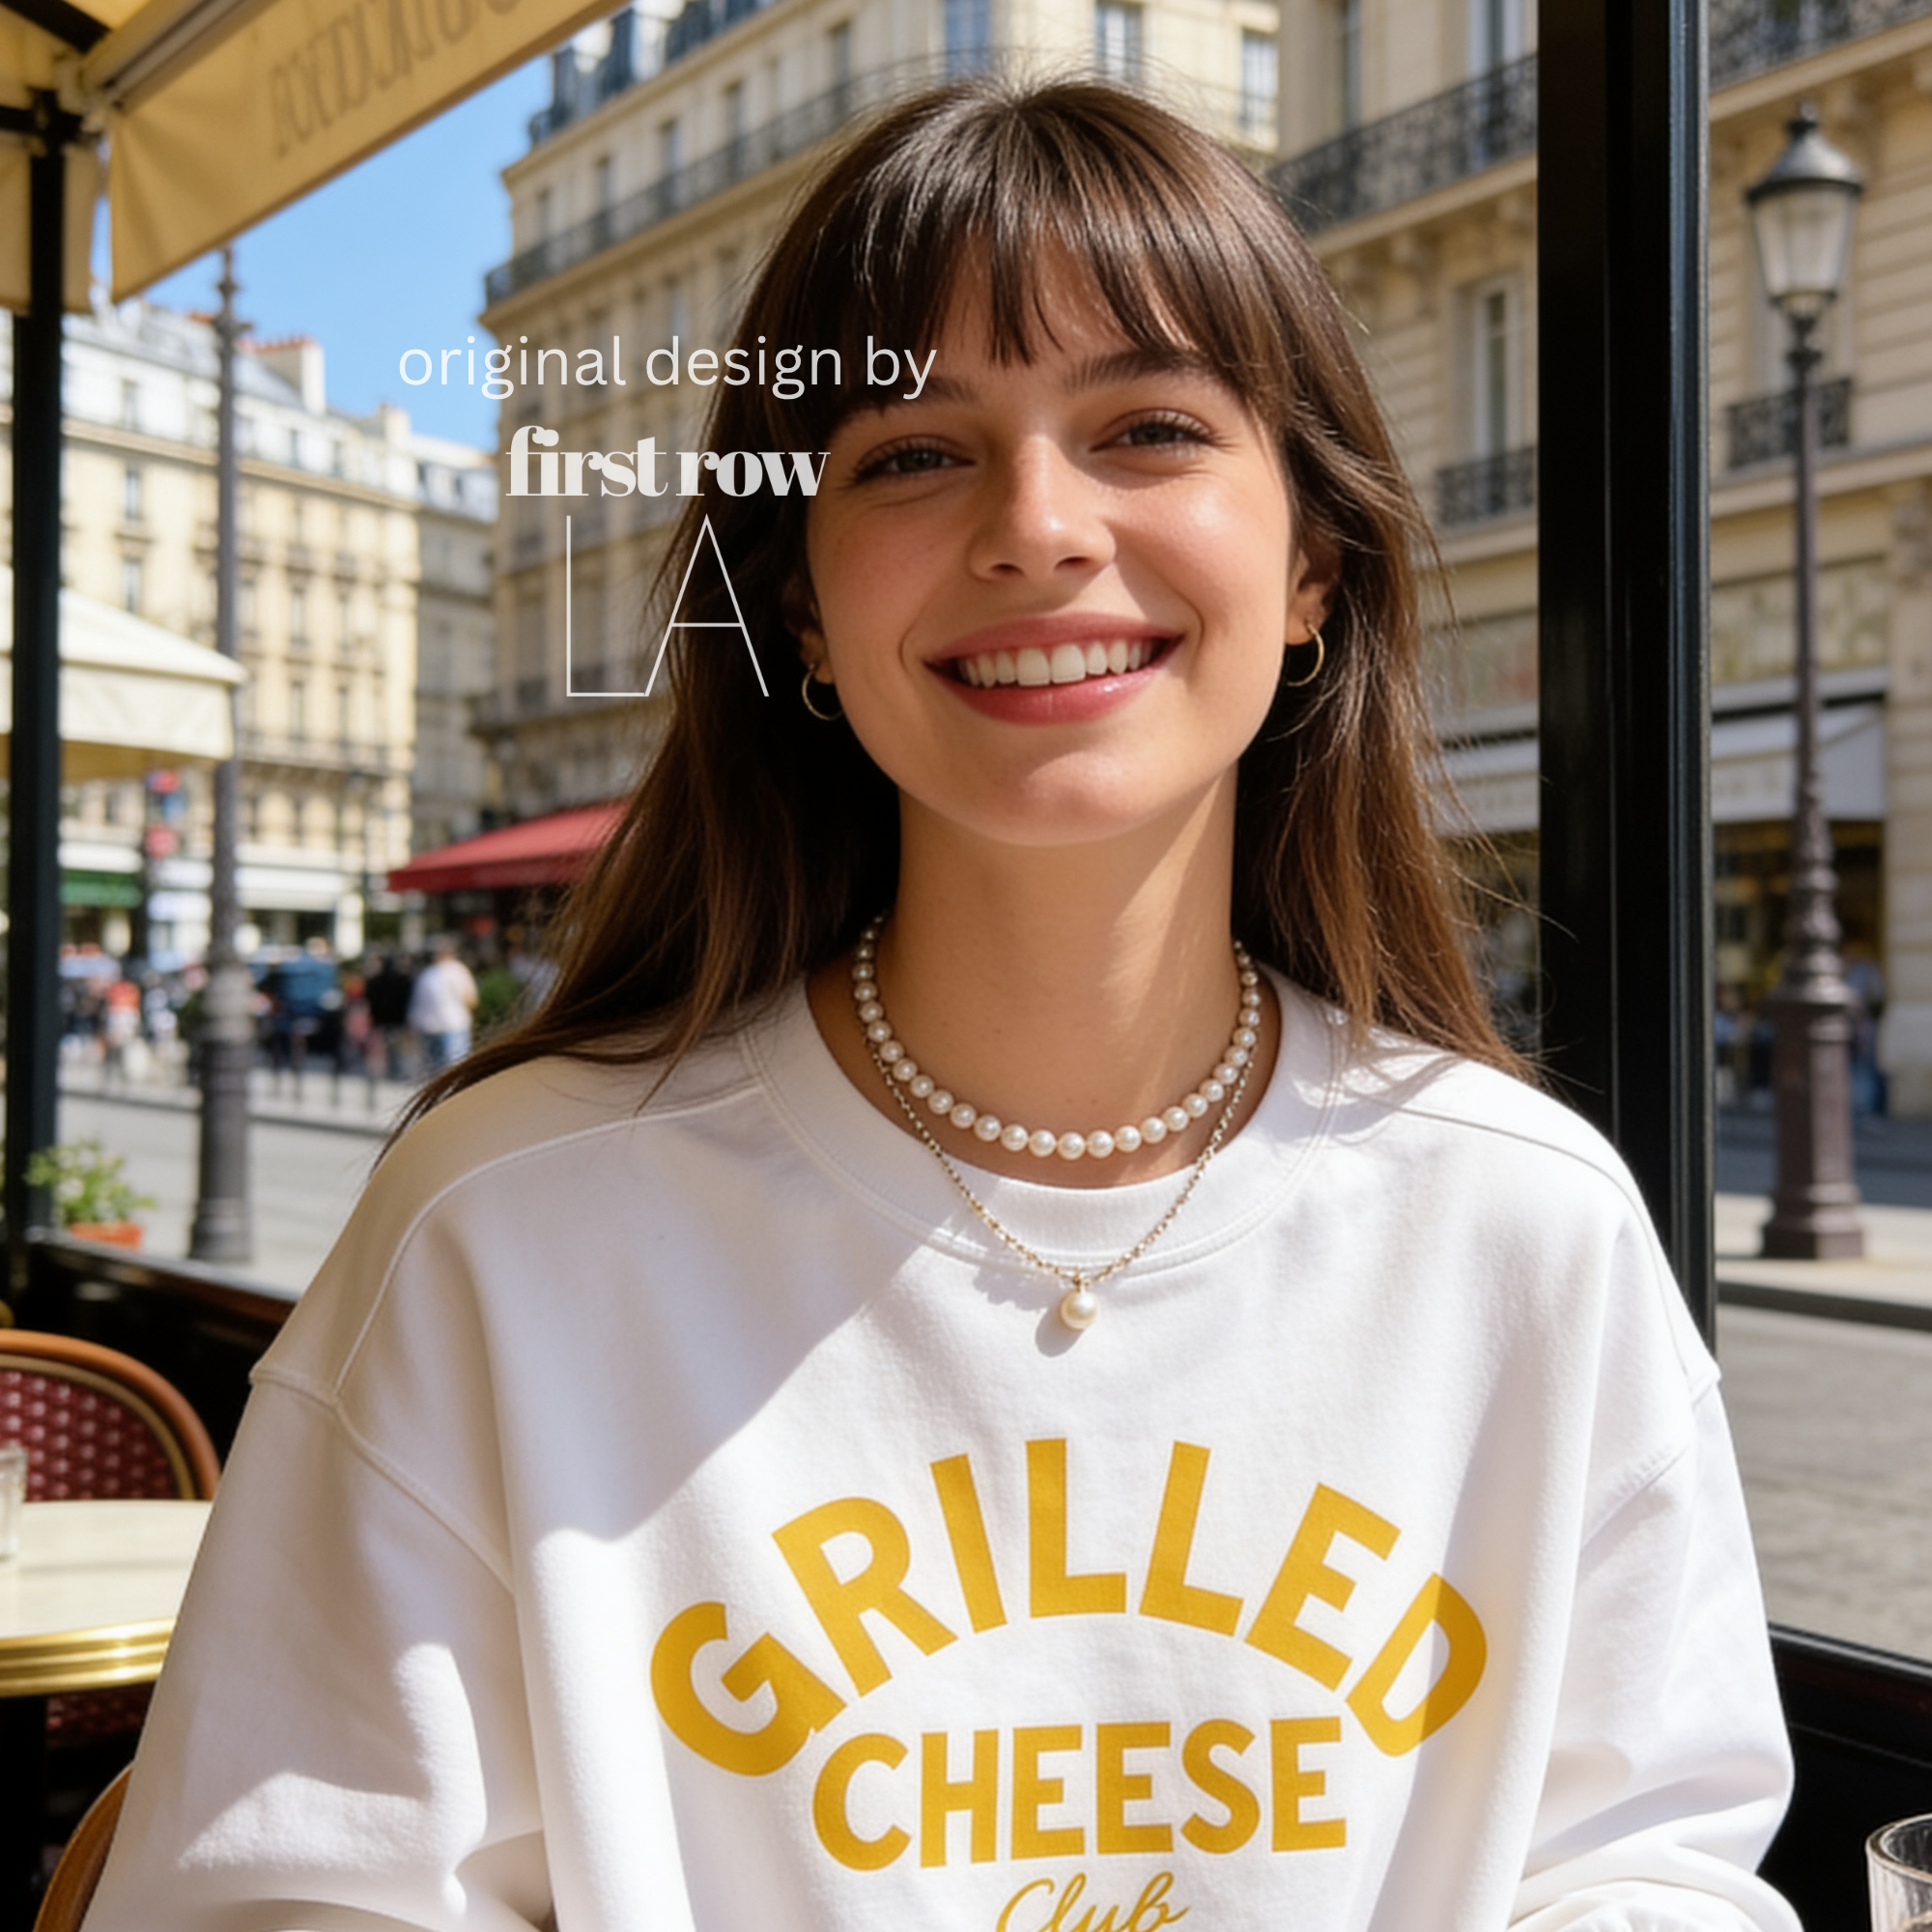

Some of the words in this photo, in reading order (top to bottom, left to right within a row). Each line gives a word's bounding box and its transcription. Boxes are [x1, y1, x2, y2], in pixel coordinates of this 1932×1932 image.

[650, 1438, 1488, 1776] GRILLED
[812, 1717, 1347, 1871] CHEESE
[996, 1871, 1191, 1932] Club
